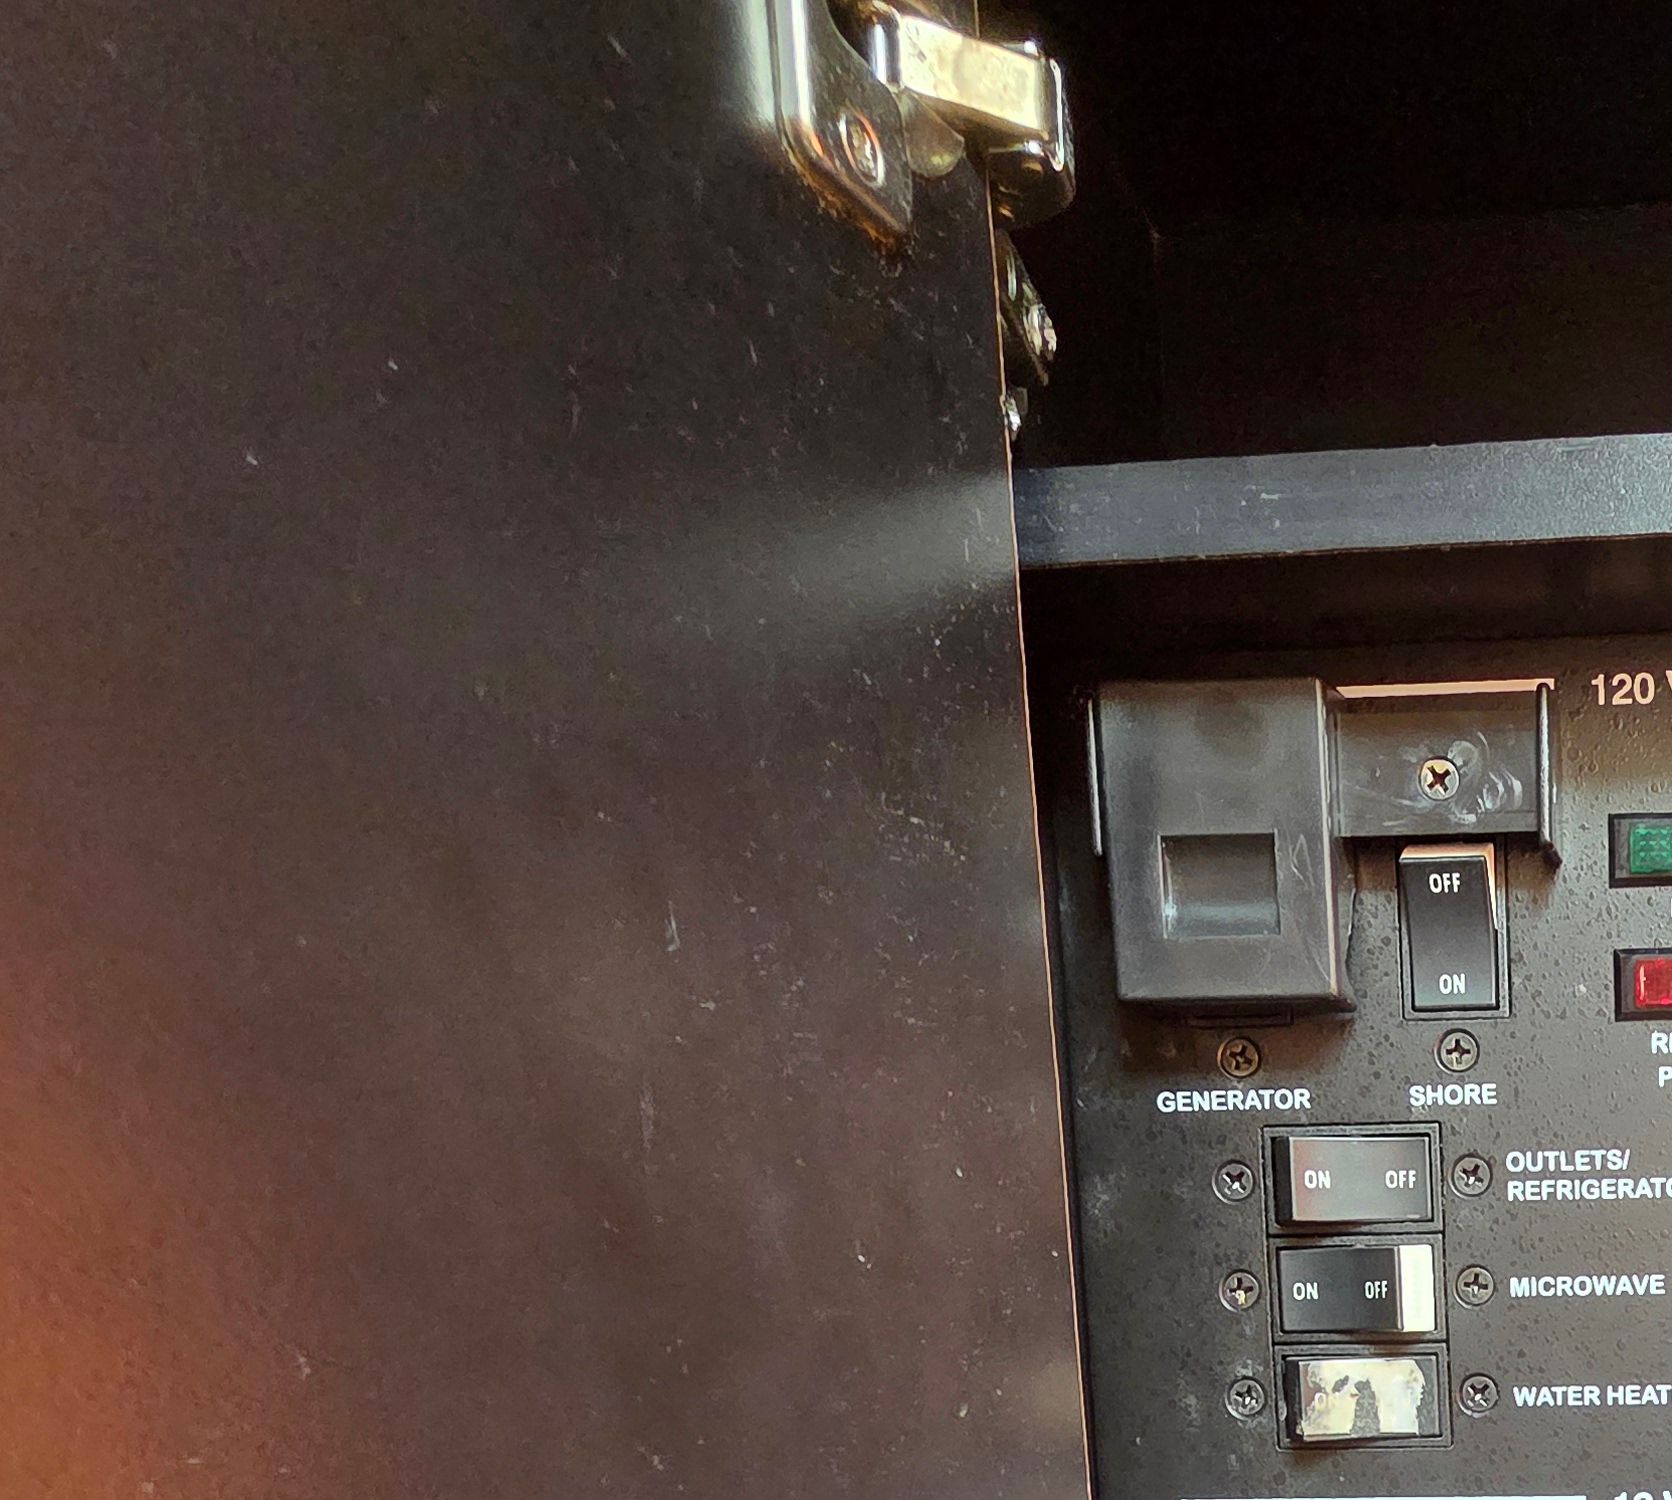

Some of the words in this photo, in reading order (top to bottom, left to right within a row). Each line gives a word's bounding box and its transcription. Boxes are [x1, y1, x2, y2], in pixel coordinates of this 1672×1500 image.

[1592, 673, 1654, 705] 120
[1429, 873, 1460, 893] OFF
[1440, 974, 1465, 994] ON
[1157, 1089, 1311, 1112] GENERATOR
[1410, 1084, 1497, 1106] SHORE
[1506, 1149, 1630, 1172] OUTLETS/
[1305, 1170, 1330, 1188] ON
[1386, 1170, 1416, 1188] OFF
[1293, 1283, 1318, 1300] ON
[1365, 1281, 1387, 1298] OFF
[1510, 1275, 1665, 1297] MICROWAVE
[1513, 1386, 1600, 1406] WATER
